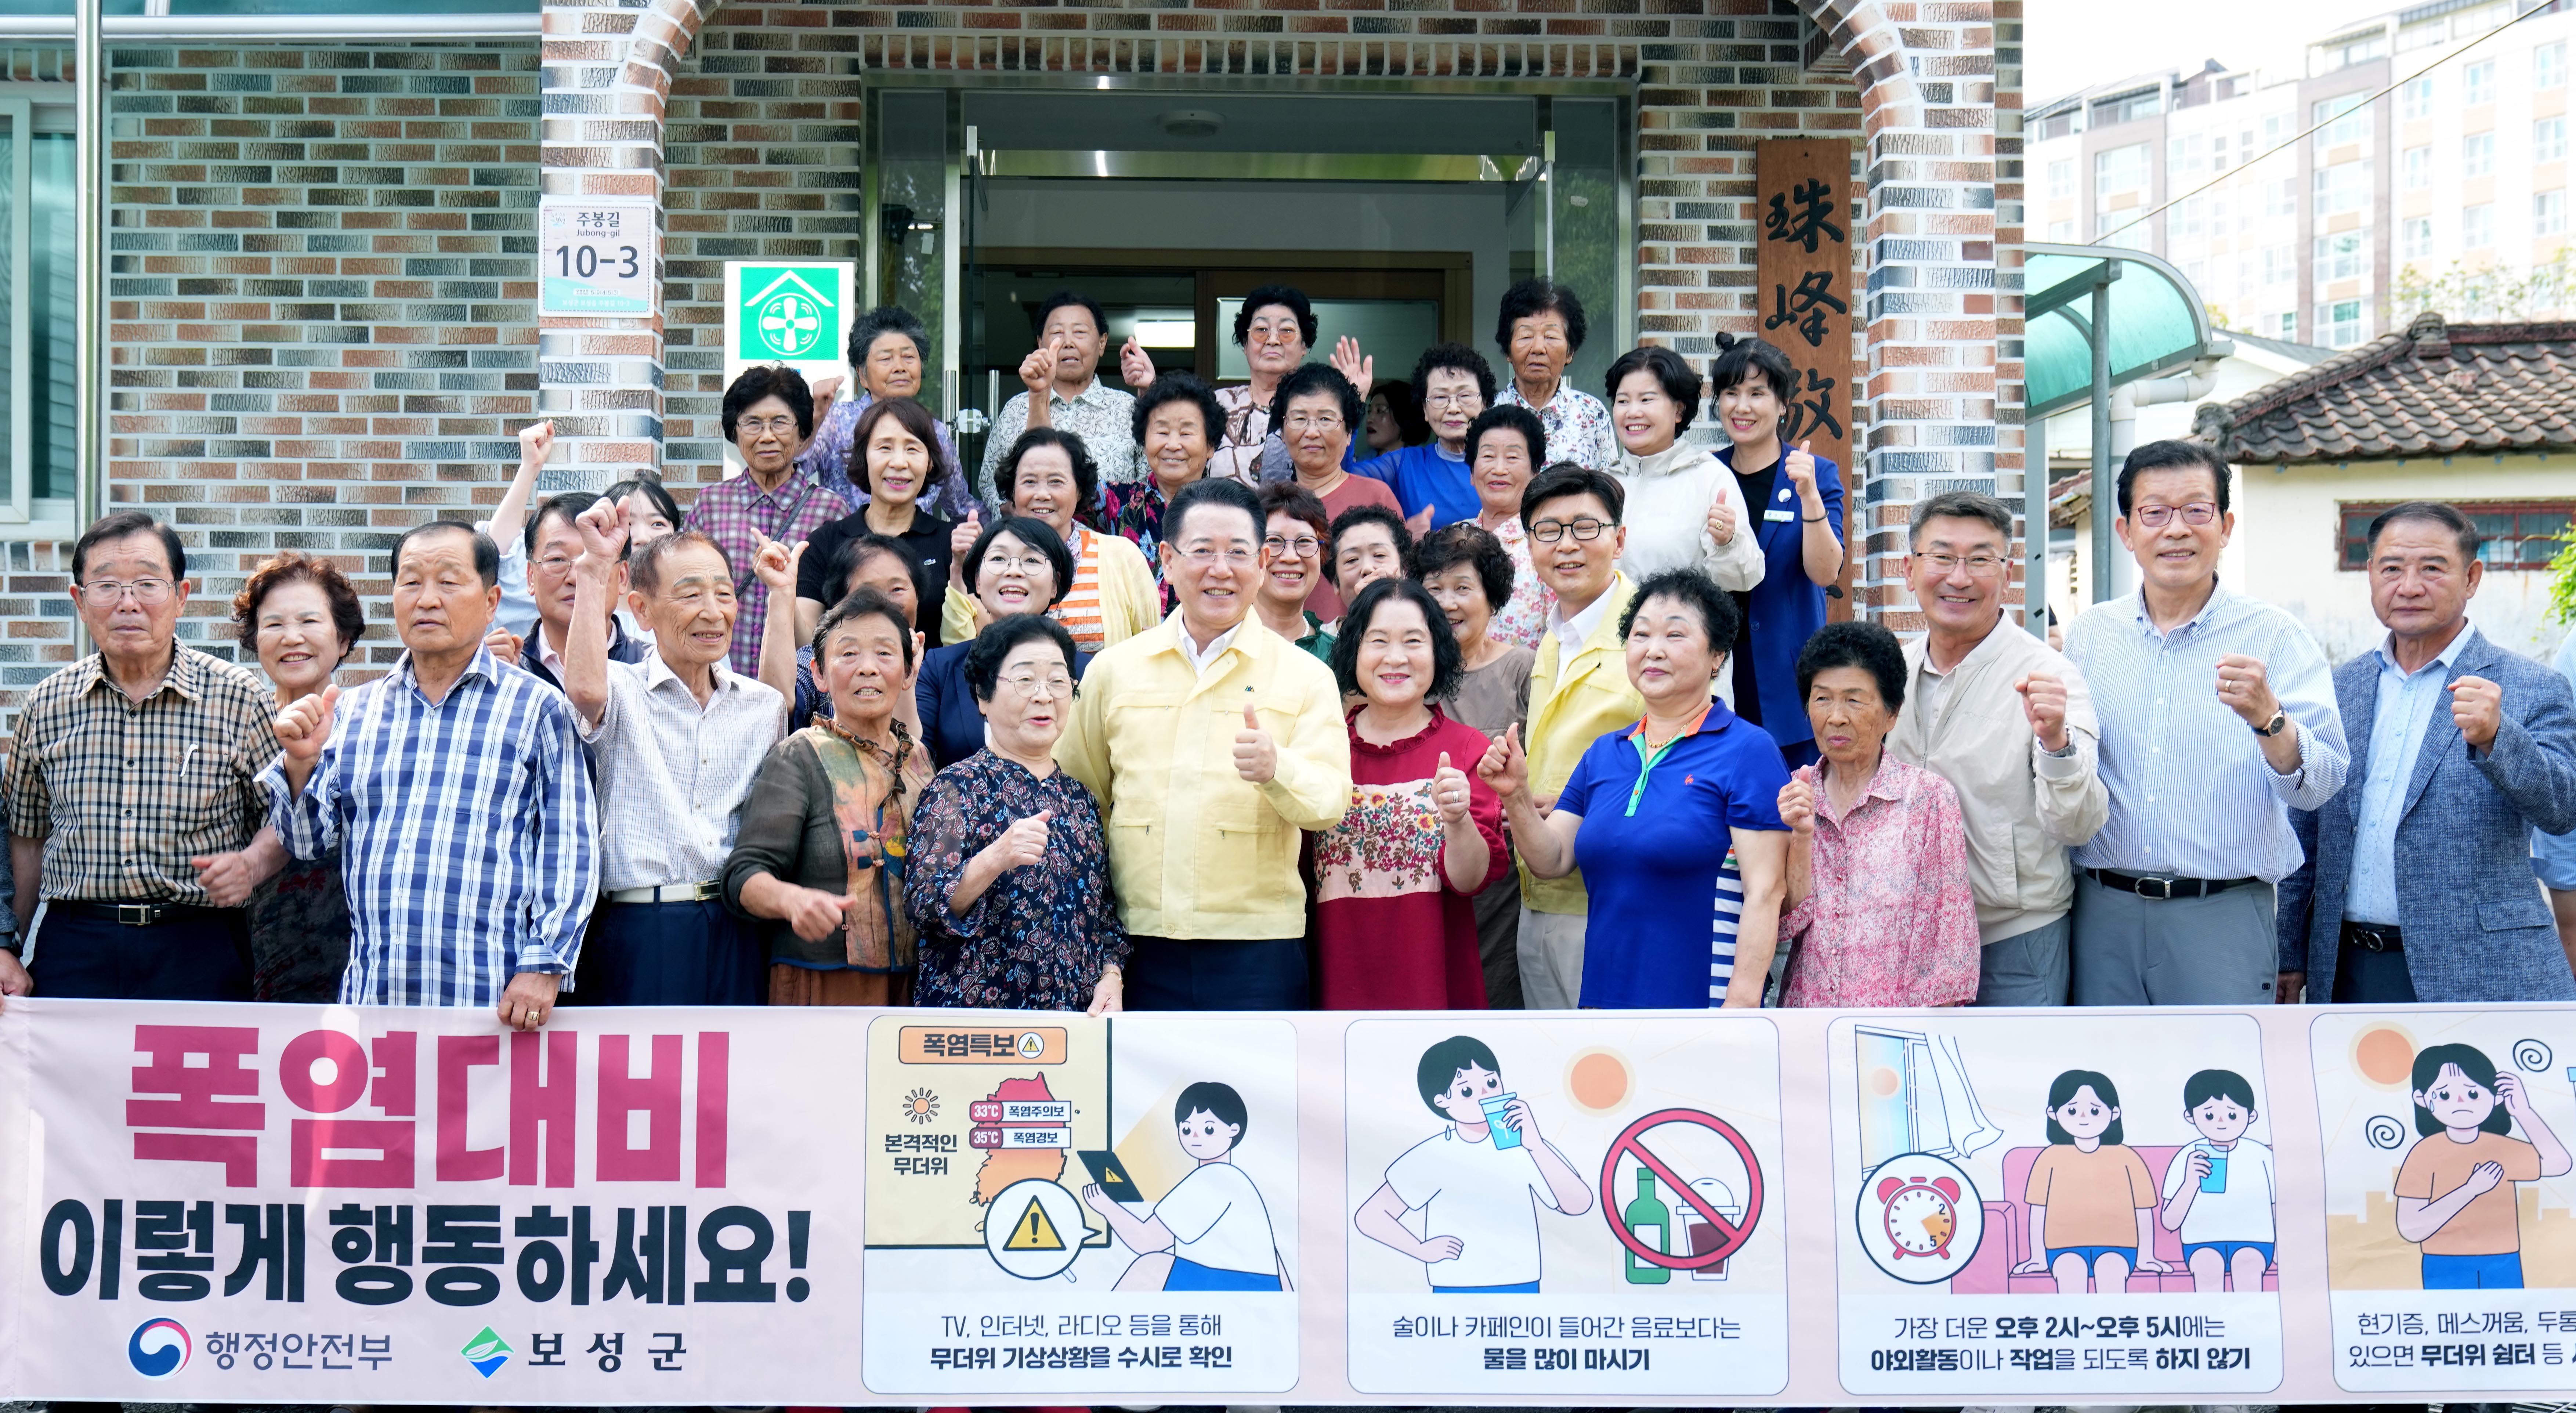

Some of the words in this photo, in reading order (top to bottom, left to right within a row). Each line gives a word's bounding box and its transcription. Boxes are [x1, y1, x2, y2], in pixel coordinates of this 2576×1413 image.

[576, 212, 619, 228] 주봉길
[576, 229, 620, 238] Jubong-gil
[556, 245, 639, 278] 10-3
[923, 1034, 1015, 1057] 폭염특보
[126, 1024, 730, 1189] 폭염대비
[1009, 1106, 1064, 1117] 폭염주의보
[884, 1134, 957, 1153] 본격적인
[1014, 1132, 1058, 1143] 폭염경보
[894, 1157, 948, 1175] 무더위
[1938, 1203, 1946, 1215] 2
[1930, 1235, 1937, 1247] 5
[40, 1199, 305, 1302] 이렇게
[329, 1203, 811, 1307] 행동하세요!
[941, 1316, 970, 1338] TV,
[981, 1315, 1048, 1337] 인터넷,
[1059, 1315, 1122, 1336] 라디오
[1129, 1315, 1172, 1336] 등을
[1179, 1314, 1221, 1336] 통해
[1393, 1316, 1459, 1337] 술이나
[1465, 1316, 1551, 1338] 카페인이
[1559, 1317, 1625, 1338] 들어간
[1631, 1317, 1741, 1339] 음료보다는
[1895, 1318, 1939, 1339] 가장
[1946, 1317, 1988, 1339] 더운
[1995, 1316, 2039, 1339] 오후
[2045, 1316, 2139, 1338] 2시~오후
[2146, 1316, 2225, 1338] 5시에는
[2358, 1313, 2428, 1336] 현기증,
[2438, 1312, 2528, 1334] 메스꺼움,
[2537, 1311, 2576, 1333] 두통
[206, 1331, 392, 1370] 행정안전부
[930, 1347, 995, 1370] 무더위
[1003, 1347, 1111, 1369] 기상상황을
[1118, 1346, 1182, 1368] 수시로
[1189, 1346, 1232, 1368] 확인
[1484, 1348, 1527, 1370] 물을
[1534, 1348, 1577, 1370] 많이
[1585, 1348, 1649, 1370] 마시기
[1871, 1349, 2004, 1371] 야외활동이나
[2010, 1348, 2075, 1371] 작업을
[2083, 1349, 2148, 1370] 되도록
[2156, 1348, 2199, 1370] 하지
[2207, 1348, 2250, 1369] 않기
[2349, 1345, 2413, 1367] 있으면
[2421, 1344, 2485, 1367] 무더위
[2492, 1343, 2535, 1365] 쉼터
[2542, 1343, 2563, 1365] 등
